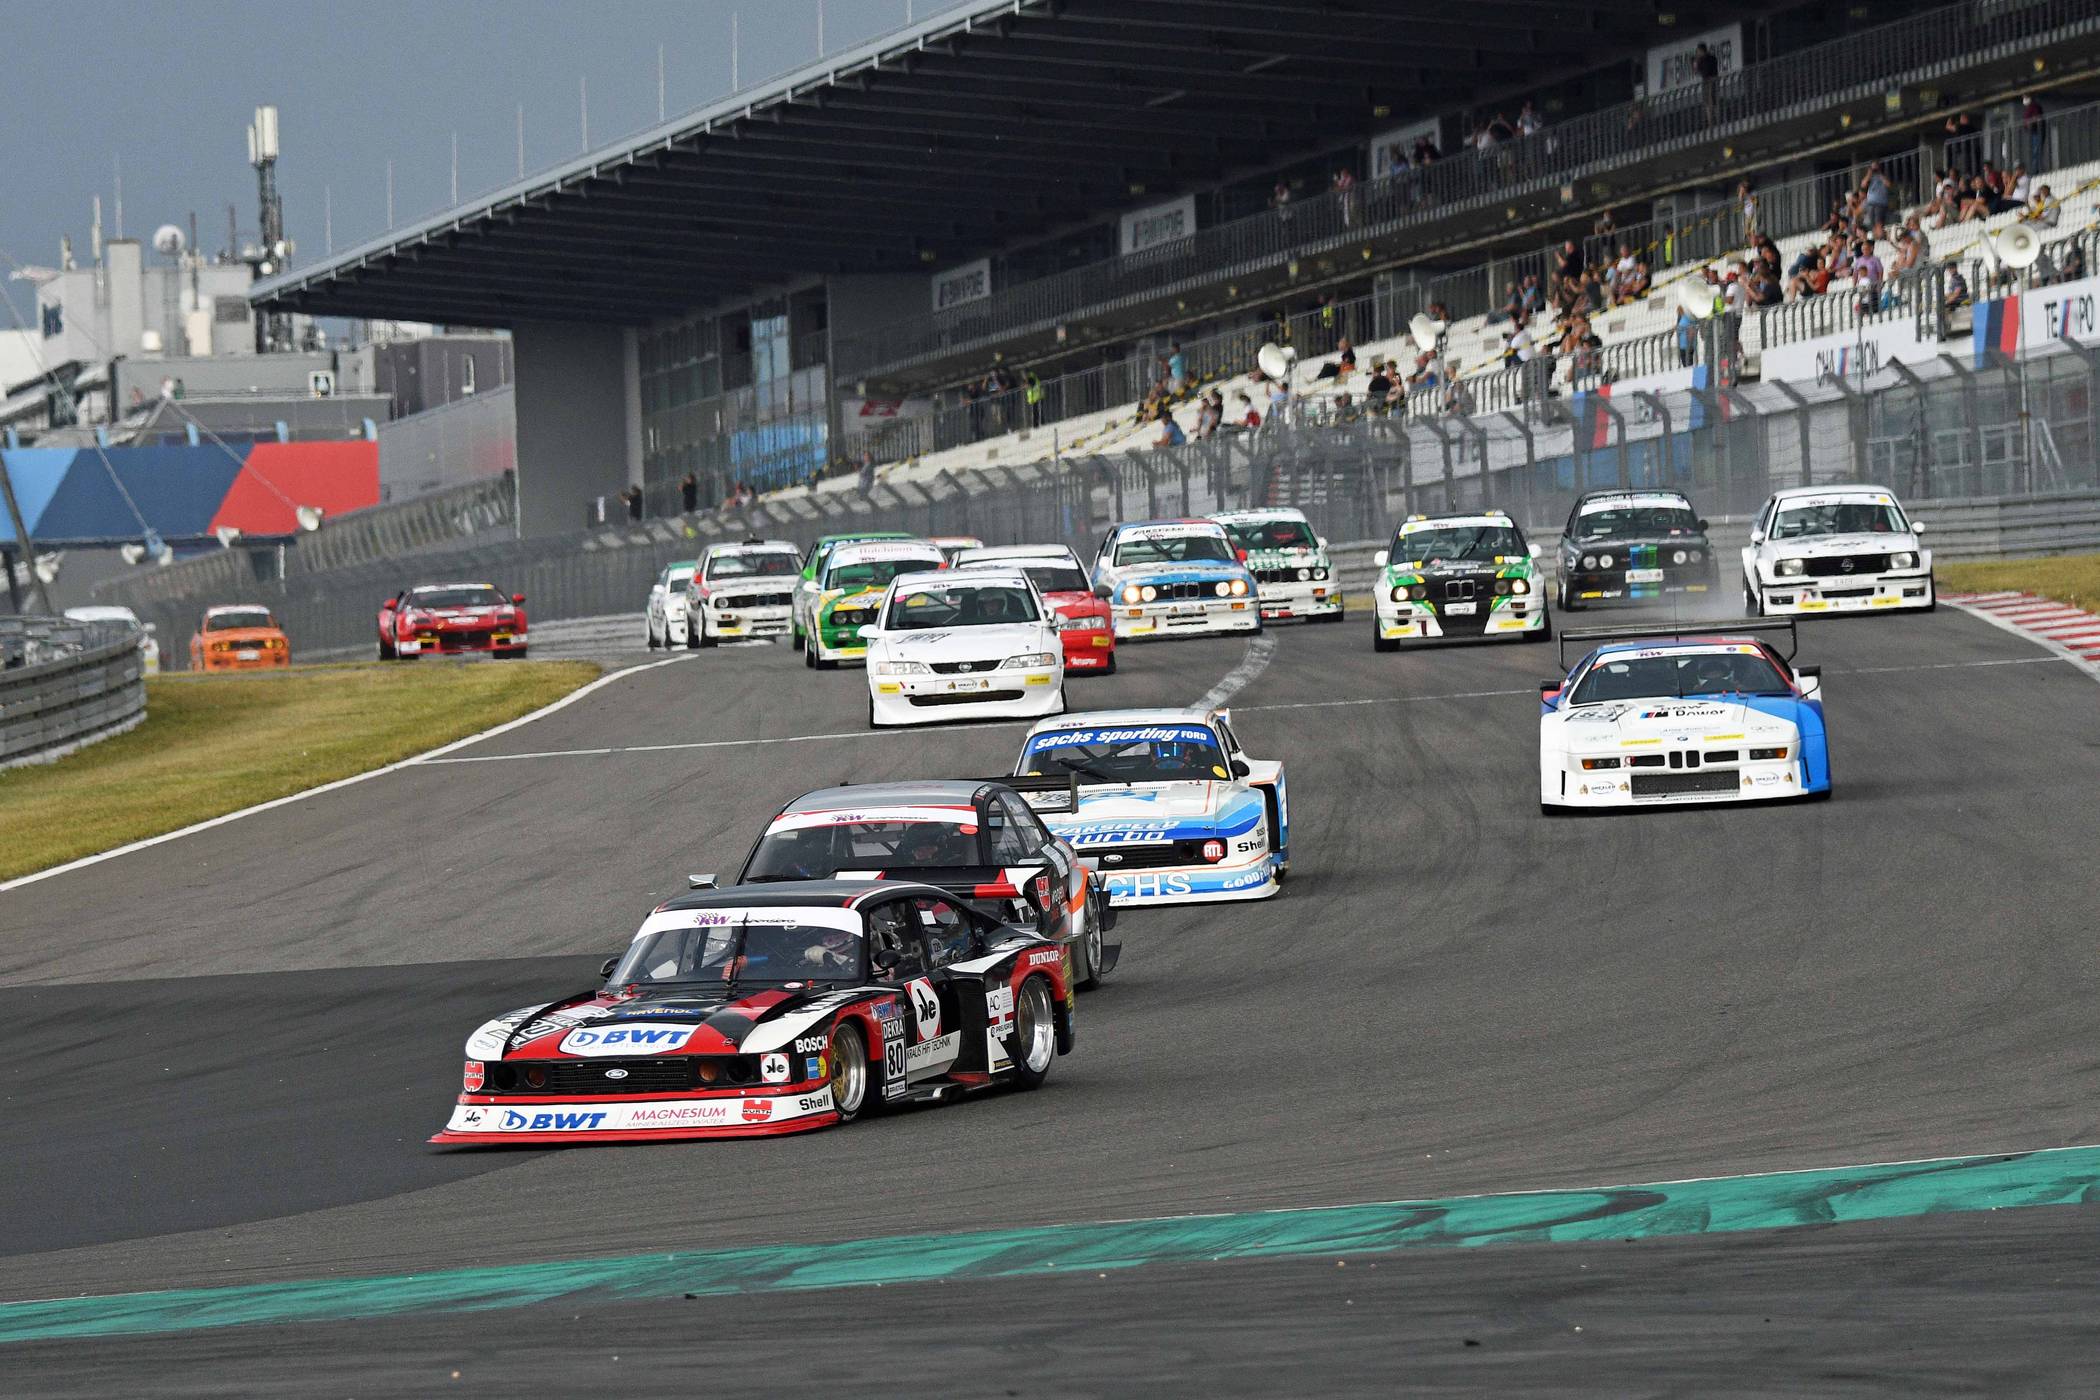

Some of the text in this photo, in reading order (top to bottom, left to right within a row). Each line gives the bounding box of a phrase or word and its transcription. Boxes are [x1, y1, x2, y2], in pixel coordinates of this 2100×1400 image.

[1035, 727, 1208, 750] sachs sporting FORD
[1069, 831, 1165, 845] turbo
[1237, 838, 1266, 852] Shell
[1203, 845, 1223, 858] RTL
[1105, 872, 1192, 898] CHS
[1029, 950, 1059, 966] DUNLOP
[601, 1030, 690, 1044] BWT
[883, 1019, 904, 1039] DEKRA
[795, 1035, 829, 1053] BOSCH
[888, 1042, 903, 1076] 80
[800, 1094, 829, 1111] Shell
[529, 1113, 607, 1129] BWT
[632, 1107, 727, 1121] MAGNESIUM
